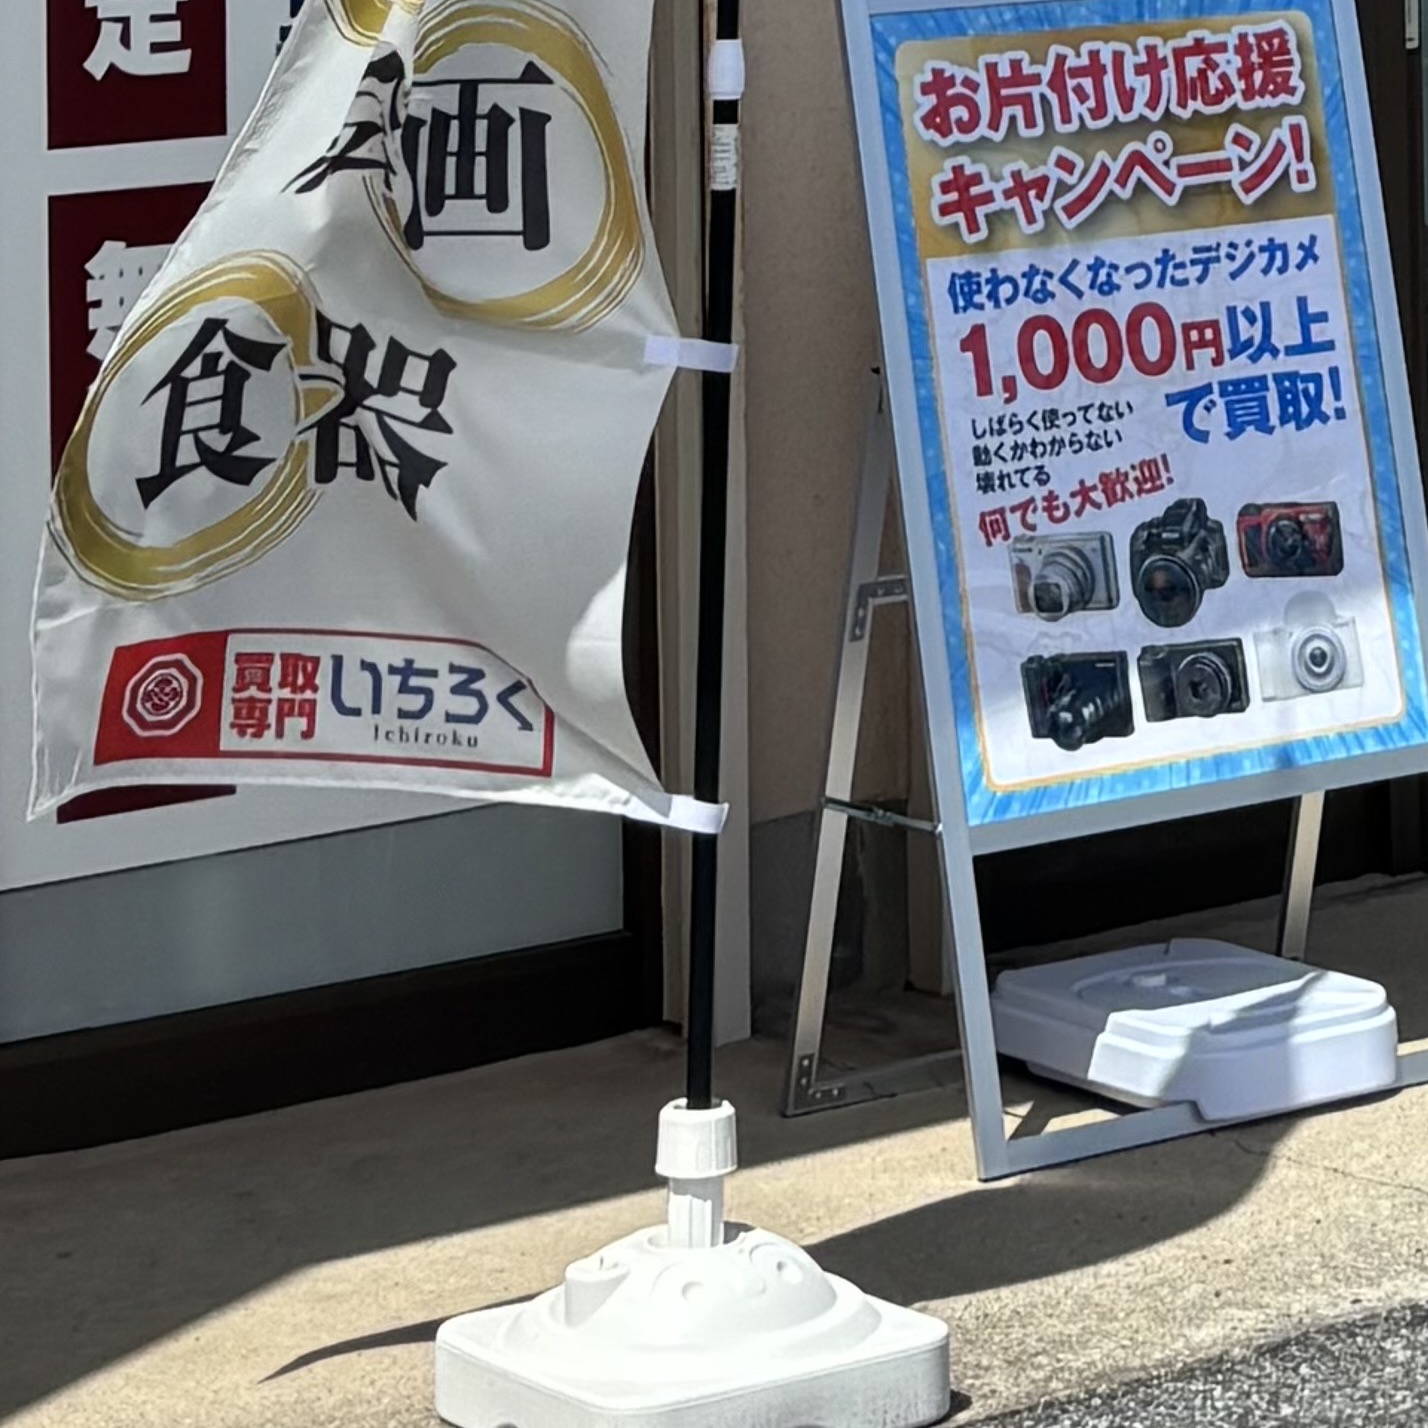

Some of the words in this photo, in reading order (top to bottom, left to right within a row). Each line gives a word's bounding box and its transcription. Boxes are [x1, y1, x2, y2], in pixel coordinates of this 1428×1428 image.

[918, 28, 1297, 140] お片付け応援
[937, 123, 1310, 238] キャンペーン!
[947, 234, 1322, 316] 使わなくなったデジカメ
[959, 294, 1337, 406] 1,000円以上
[137, 317, 458, 521] 食器
[970, 400, 1134, 440] しばらく使ってない
[1165, 366, 1347, 444] で買取!
[972, 428, 1123, 468] 動くかわからない
[975, 465, 1052, 495] 壊れてる
[977, 453, 1175, 546] 何でも大歓迎!
[234, 652, 321, 696] 買取
[330, 653, 535, 733] いちろく
[229, 696, 318, 741] 専門
[374, 723, 480, 749] Ichiroku
